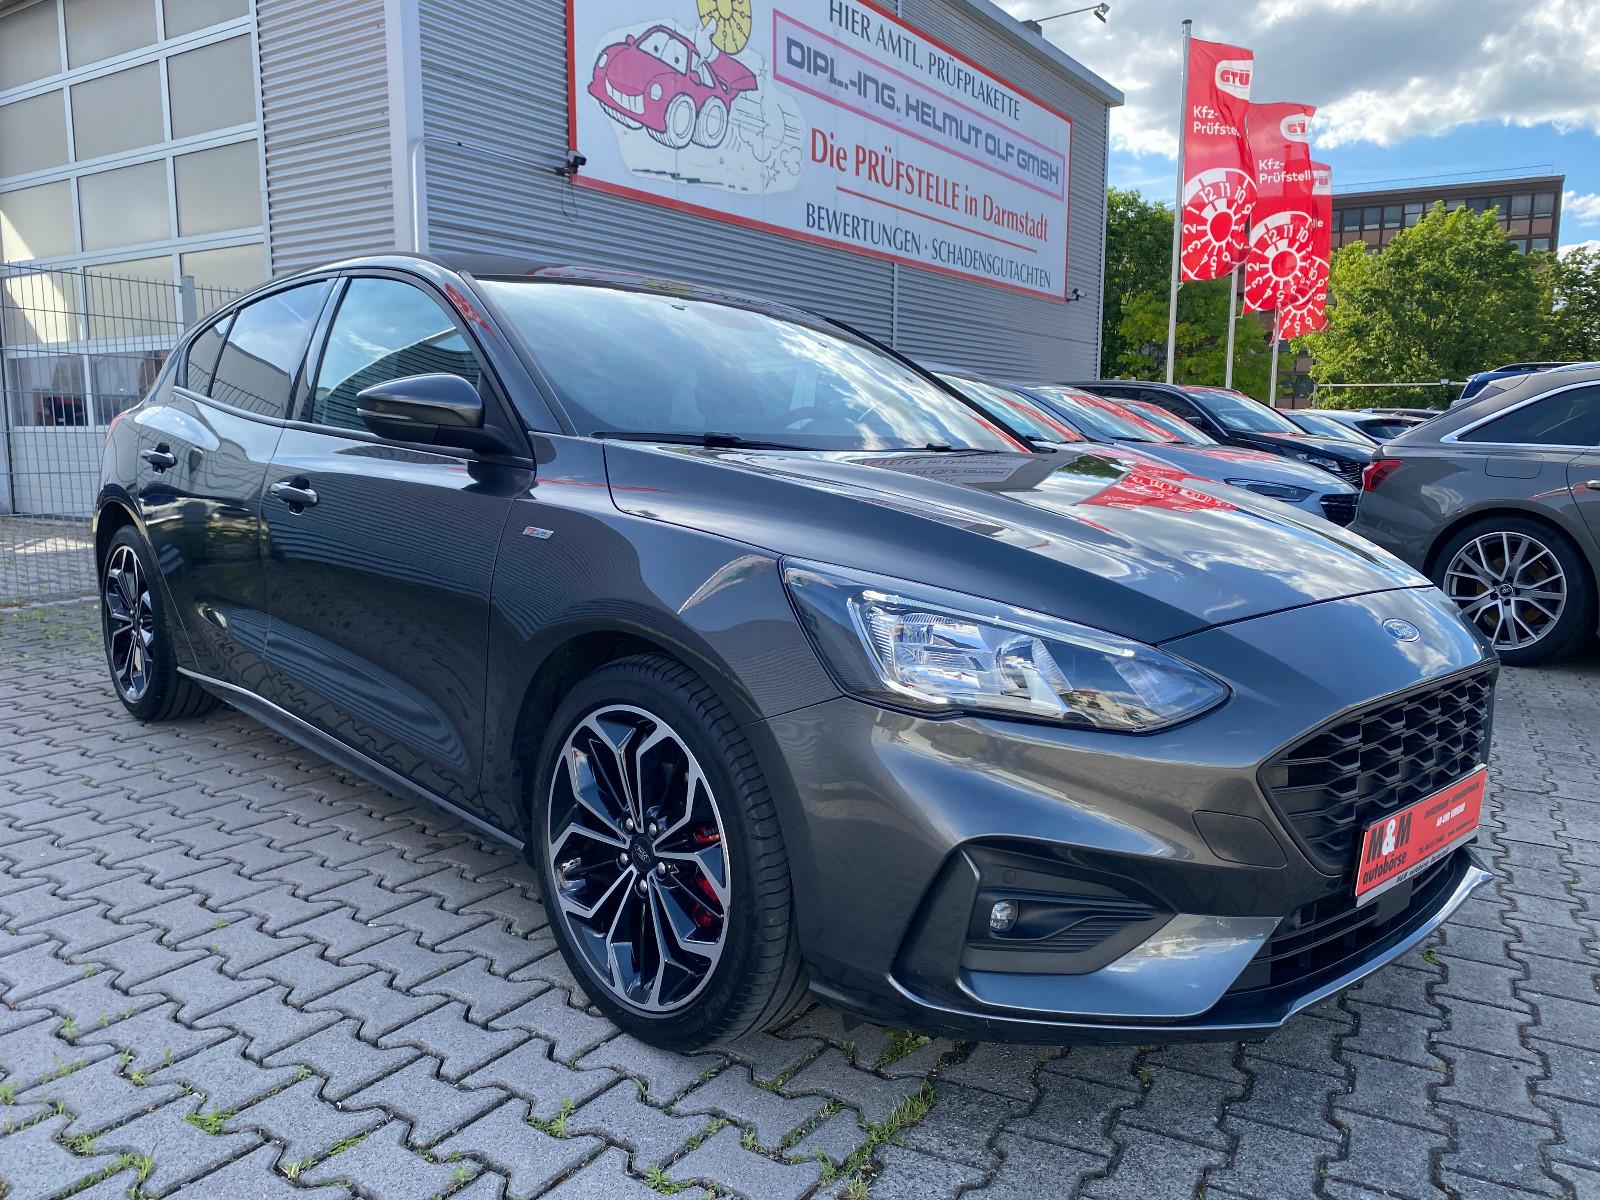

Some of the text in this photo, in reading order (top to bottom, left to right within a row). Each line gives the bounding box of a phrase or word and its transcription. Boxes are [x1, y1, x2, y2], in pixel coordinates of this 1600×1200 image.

[829, 0, 1020, 121] HIER AMTL. PRÜFPLAKETTE
[1193, 105, 1218, 119] Kfz-
[905, 93, 982, 149] HELMUT
[984, 131, 1015, 162] OLF
[1193, 121, 1241, 137] Prüfste
[1258, 158, 1285, 171] Kfz-
[811, 128, 1049, 242] Die PRÜFSTELLE in Darmstadt
[1259, 169, 1311, 185] Prüfstell
[1199, 187, 1217, 203] 12
[1219, 182, 1231, 197] 11
[1234, 186, 1246, 203] 10
[1264, 229, 1280, 245] 12
[1284, 224, 1293, 237] 11
[1296, 227, 1309, 243] 10
[806, 202, 1051, 289] BEWERTUNGEN SCHADENSGUTACHTEN
[1362, 851, 1407, 885] autobörse
